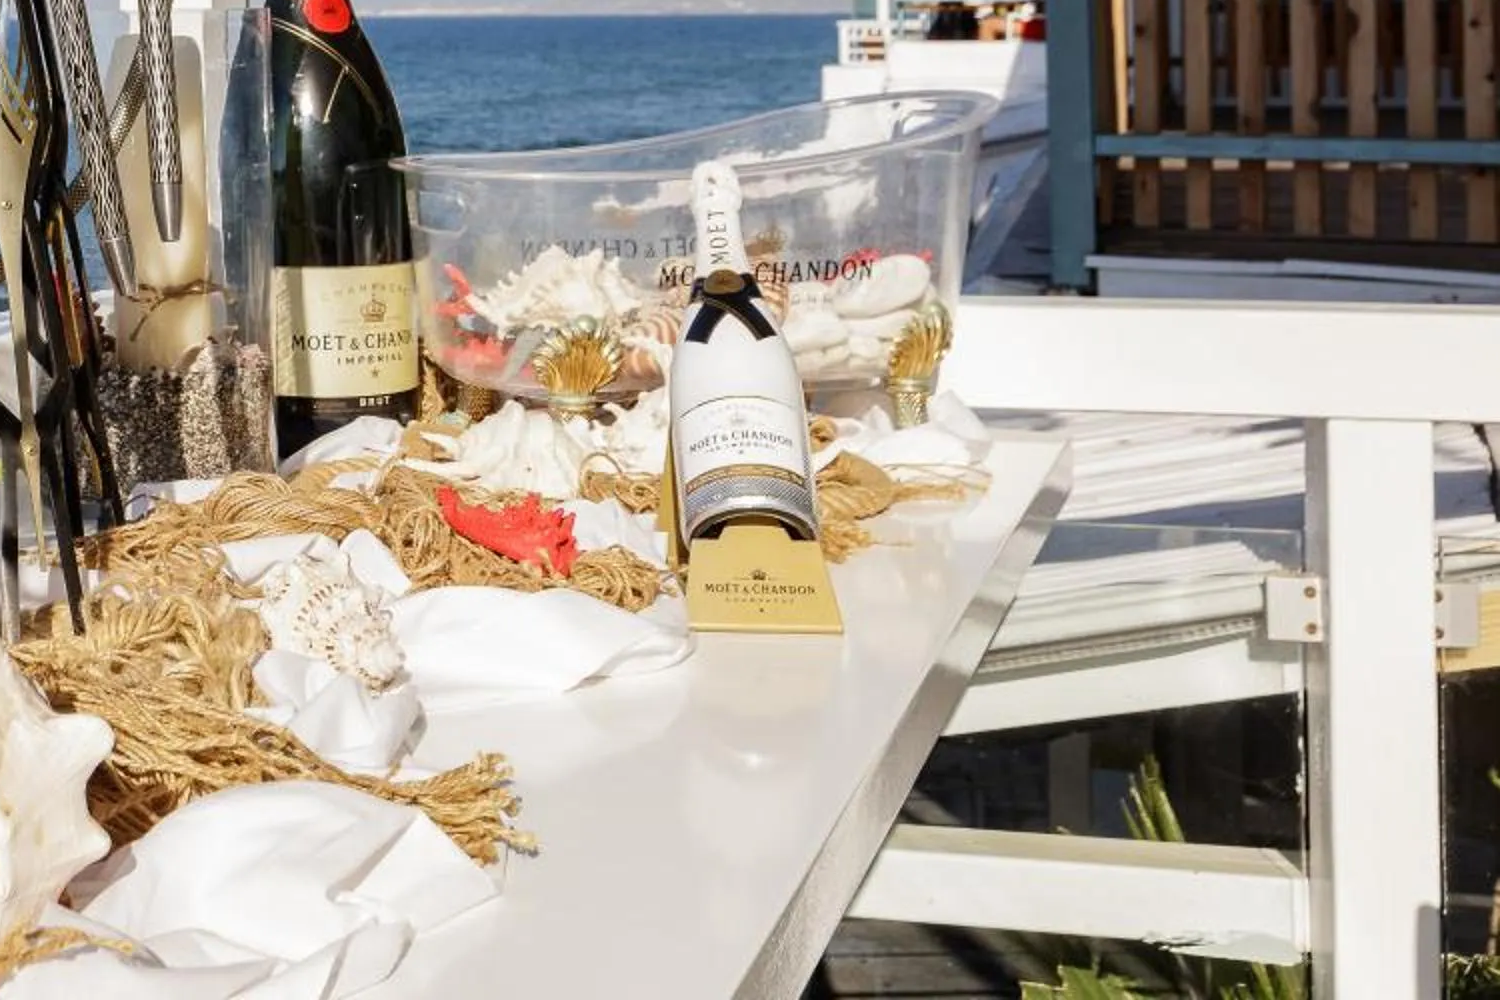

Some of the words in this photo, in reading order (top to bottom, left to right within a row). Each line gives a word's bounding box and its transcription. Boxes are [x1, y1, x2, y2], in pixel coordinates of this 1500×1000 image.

[660, 264, 697, 290] MO
[755, 258, 874, 284] CHANDON
[349, 337, 361, 351] &
[751, 584, 816, 595] CHANDON
